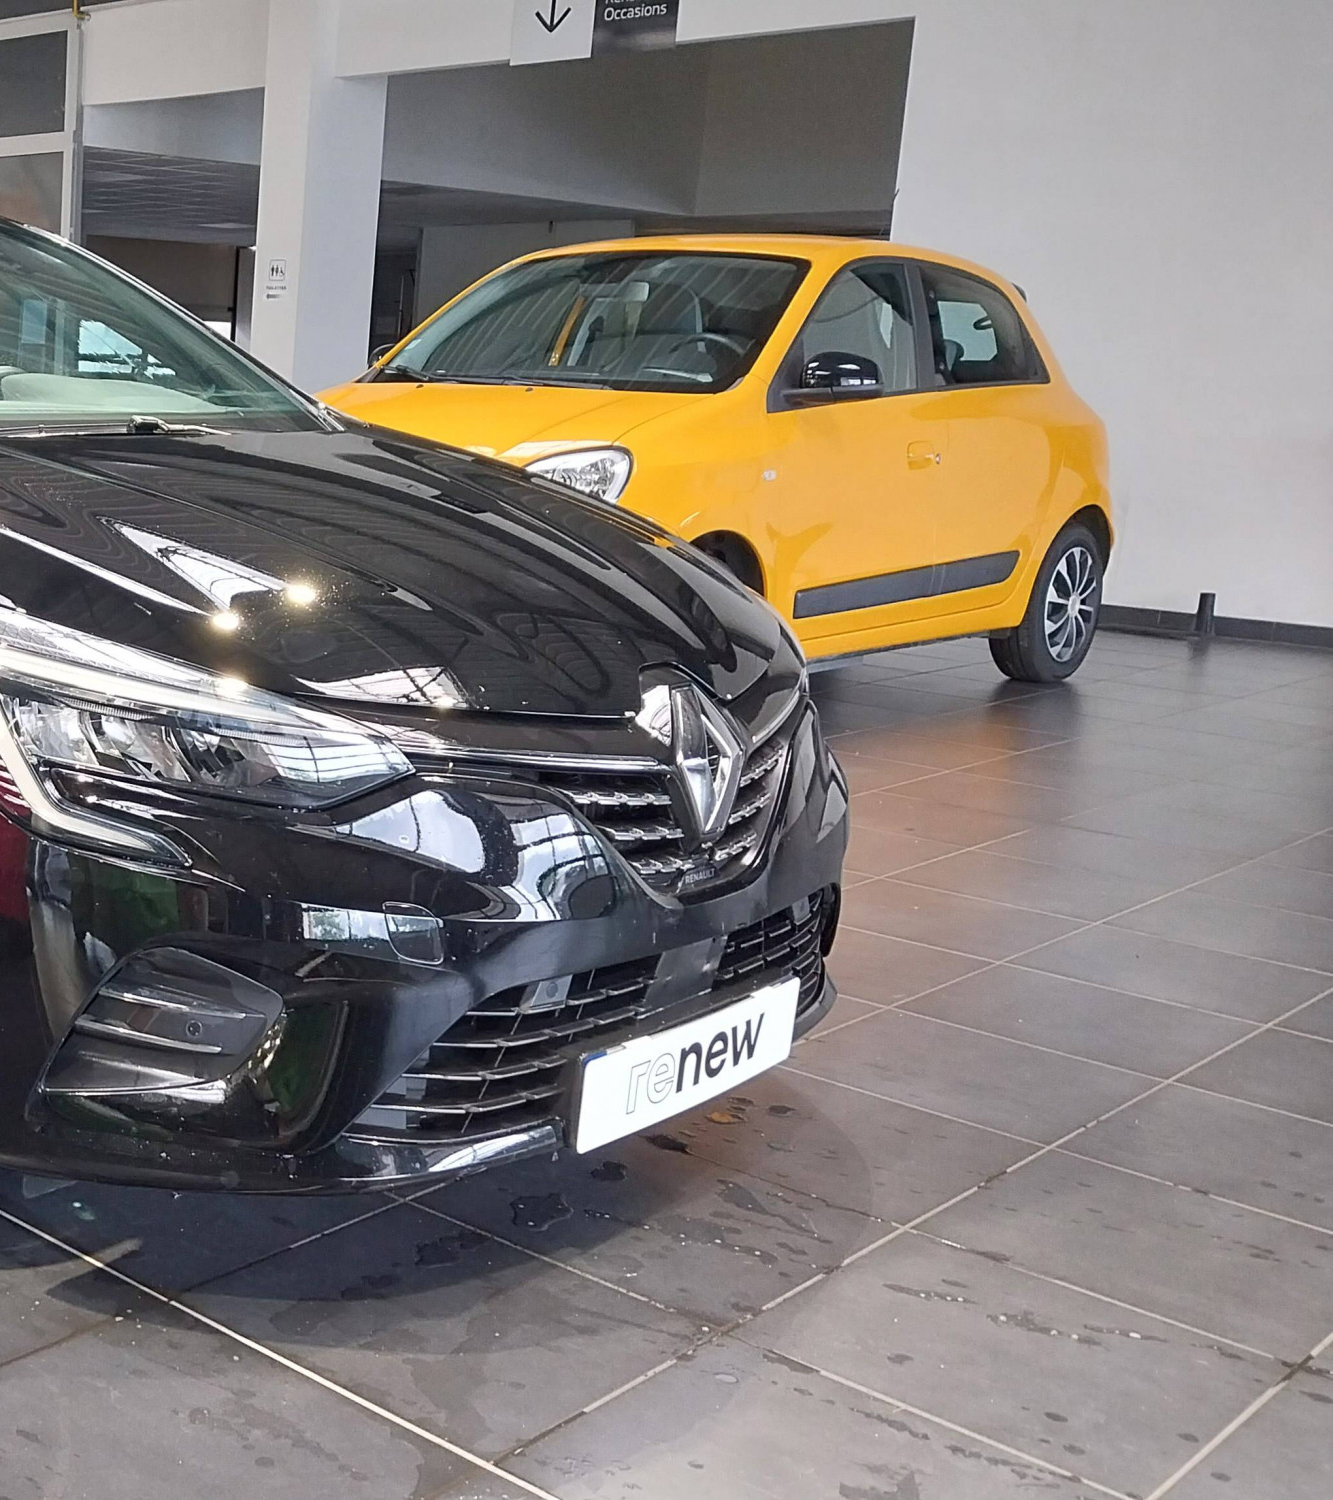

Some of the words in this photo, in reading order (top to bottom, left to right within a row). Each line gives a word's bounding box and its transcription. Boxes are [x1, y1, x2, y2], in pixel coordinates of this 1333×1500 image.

[603, 3, 667, 21] Occasions
[685, 868, 715, 884] RENAULT
[625, 1012, 765, 1115] renew
